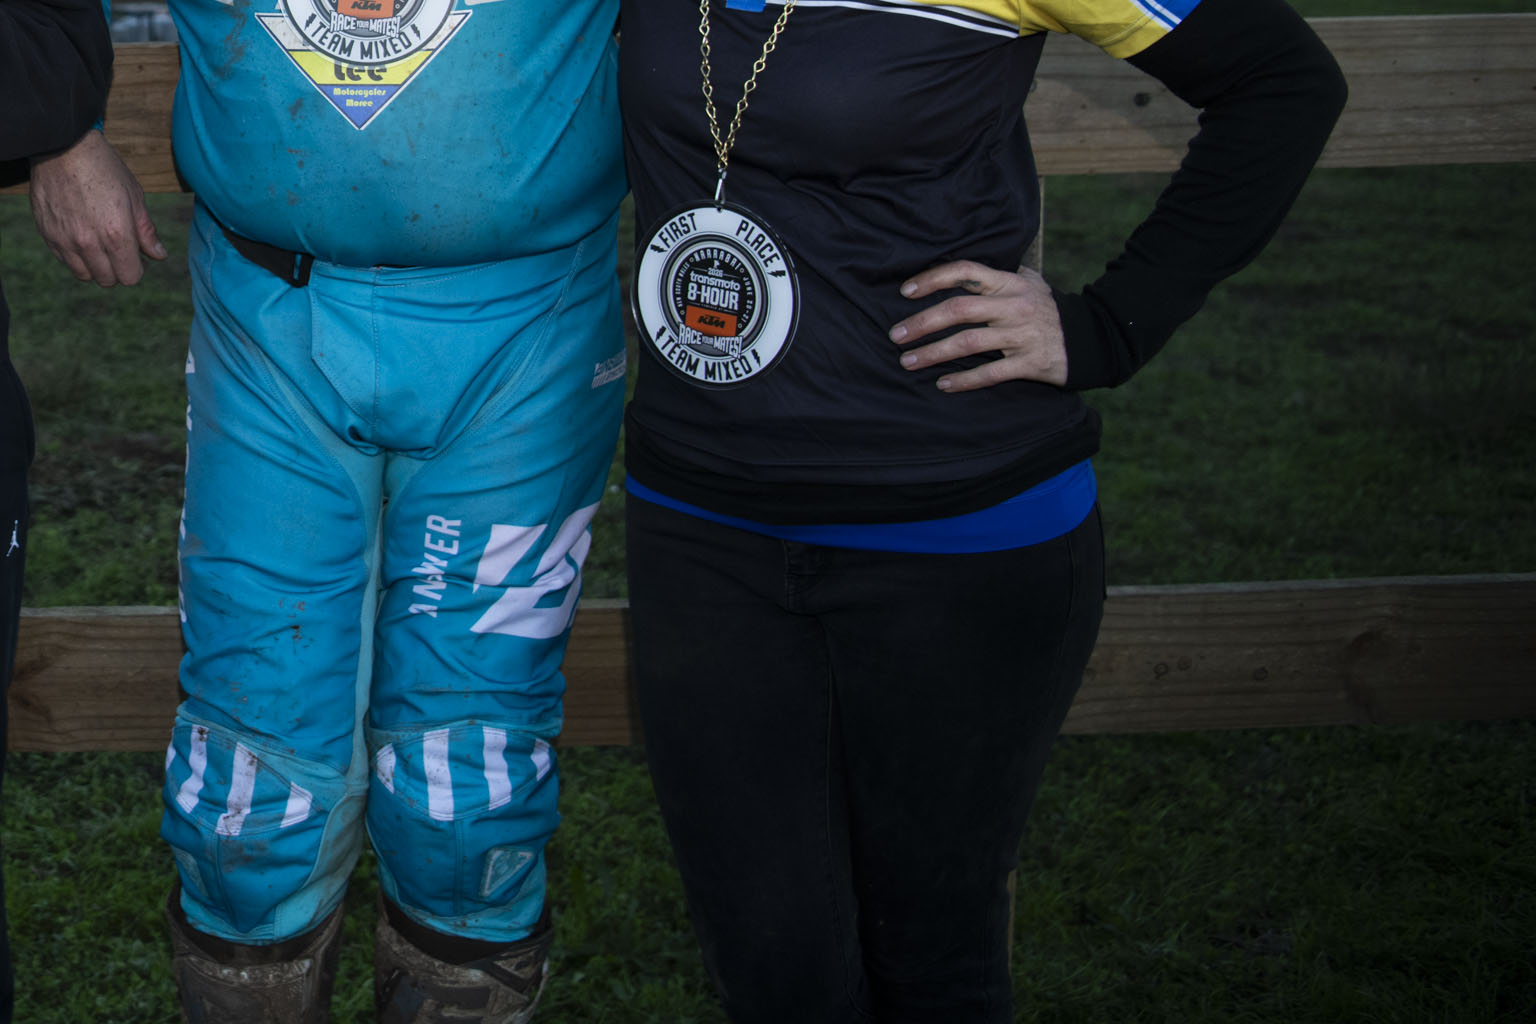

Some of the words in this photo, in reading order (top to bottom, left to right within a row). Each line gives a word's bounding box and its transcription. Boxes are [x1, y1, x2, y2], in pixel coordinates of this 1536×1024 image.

[351, 0, 382, 11] KTM
[330, 11, 356, 32] RACE
[369, 16, 401, 38] MATES!
[312, 22, 355, 60] TEAM
[359, 29, 412, 60] MIXED
[333, 88, 386, 98] Motorcycles
[658, 212, 697, 249] FIRST
[735, 219, 781, 268] PLACE
[690, 270, 741, 291] transmoto
[687, 282, 739, 311] 8-HOUR
[697, 314, 726, 329] KTM
[678, 322, 702, 345] RACE
[713, 335, 743, 359] MATES!
[660, 335, 700, 375] TEAM
[704, 356, 753, 381] MIXED
